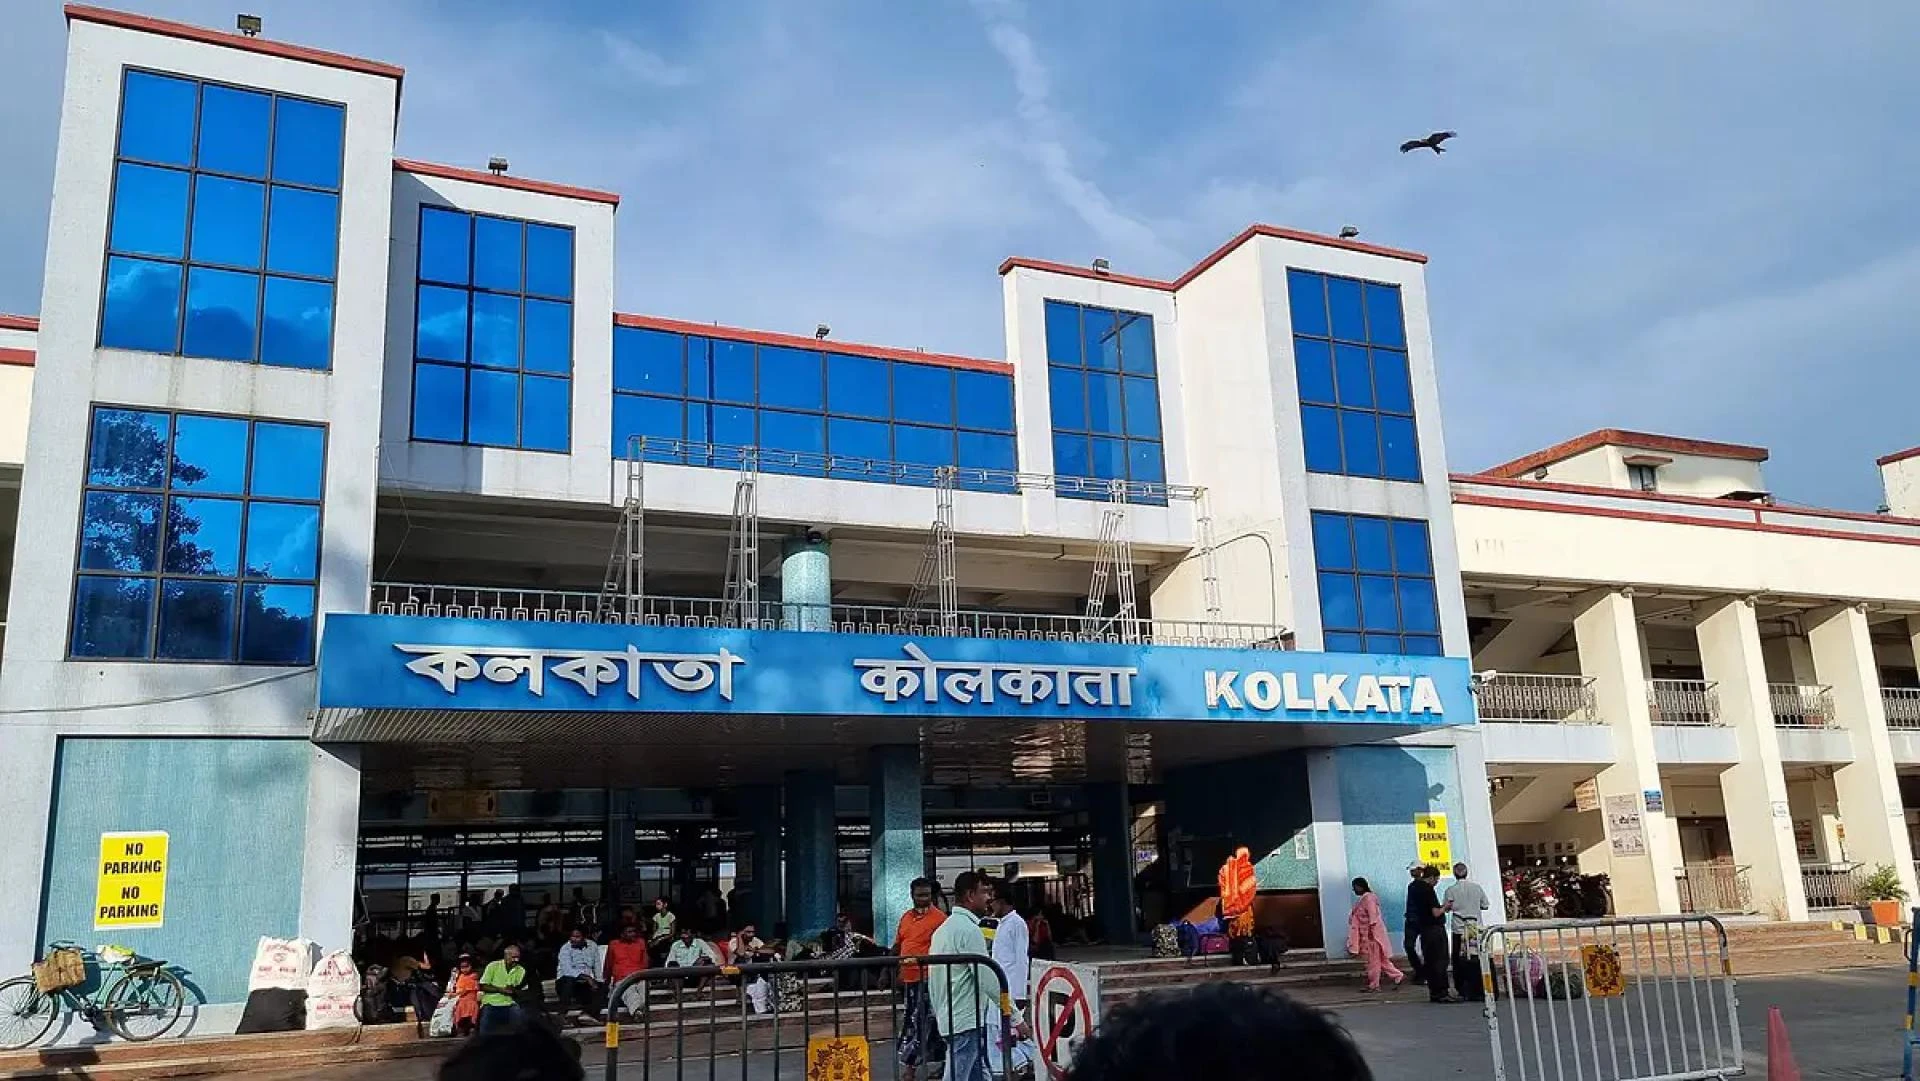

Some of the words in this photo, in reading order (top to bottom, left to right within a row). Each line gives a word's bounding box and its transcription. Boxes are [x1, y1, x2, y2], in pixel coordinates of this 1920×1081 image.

[393, 643, 745, 701] কলকাতা
[853, 642, 1138, 706] कोलकाता
[1204, 670, 1443, 714] KOLKATA
[1419, 832, 1447, 841] PARKING
[125, 842, 143, 856] NO
[103, 860, 162, 875] PARKING
[121, 886, 140, 900] NO
[100, 903, 159, 919] PARKING
